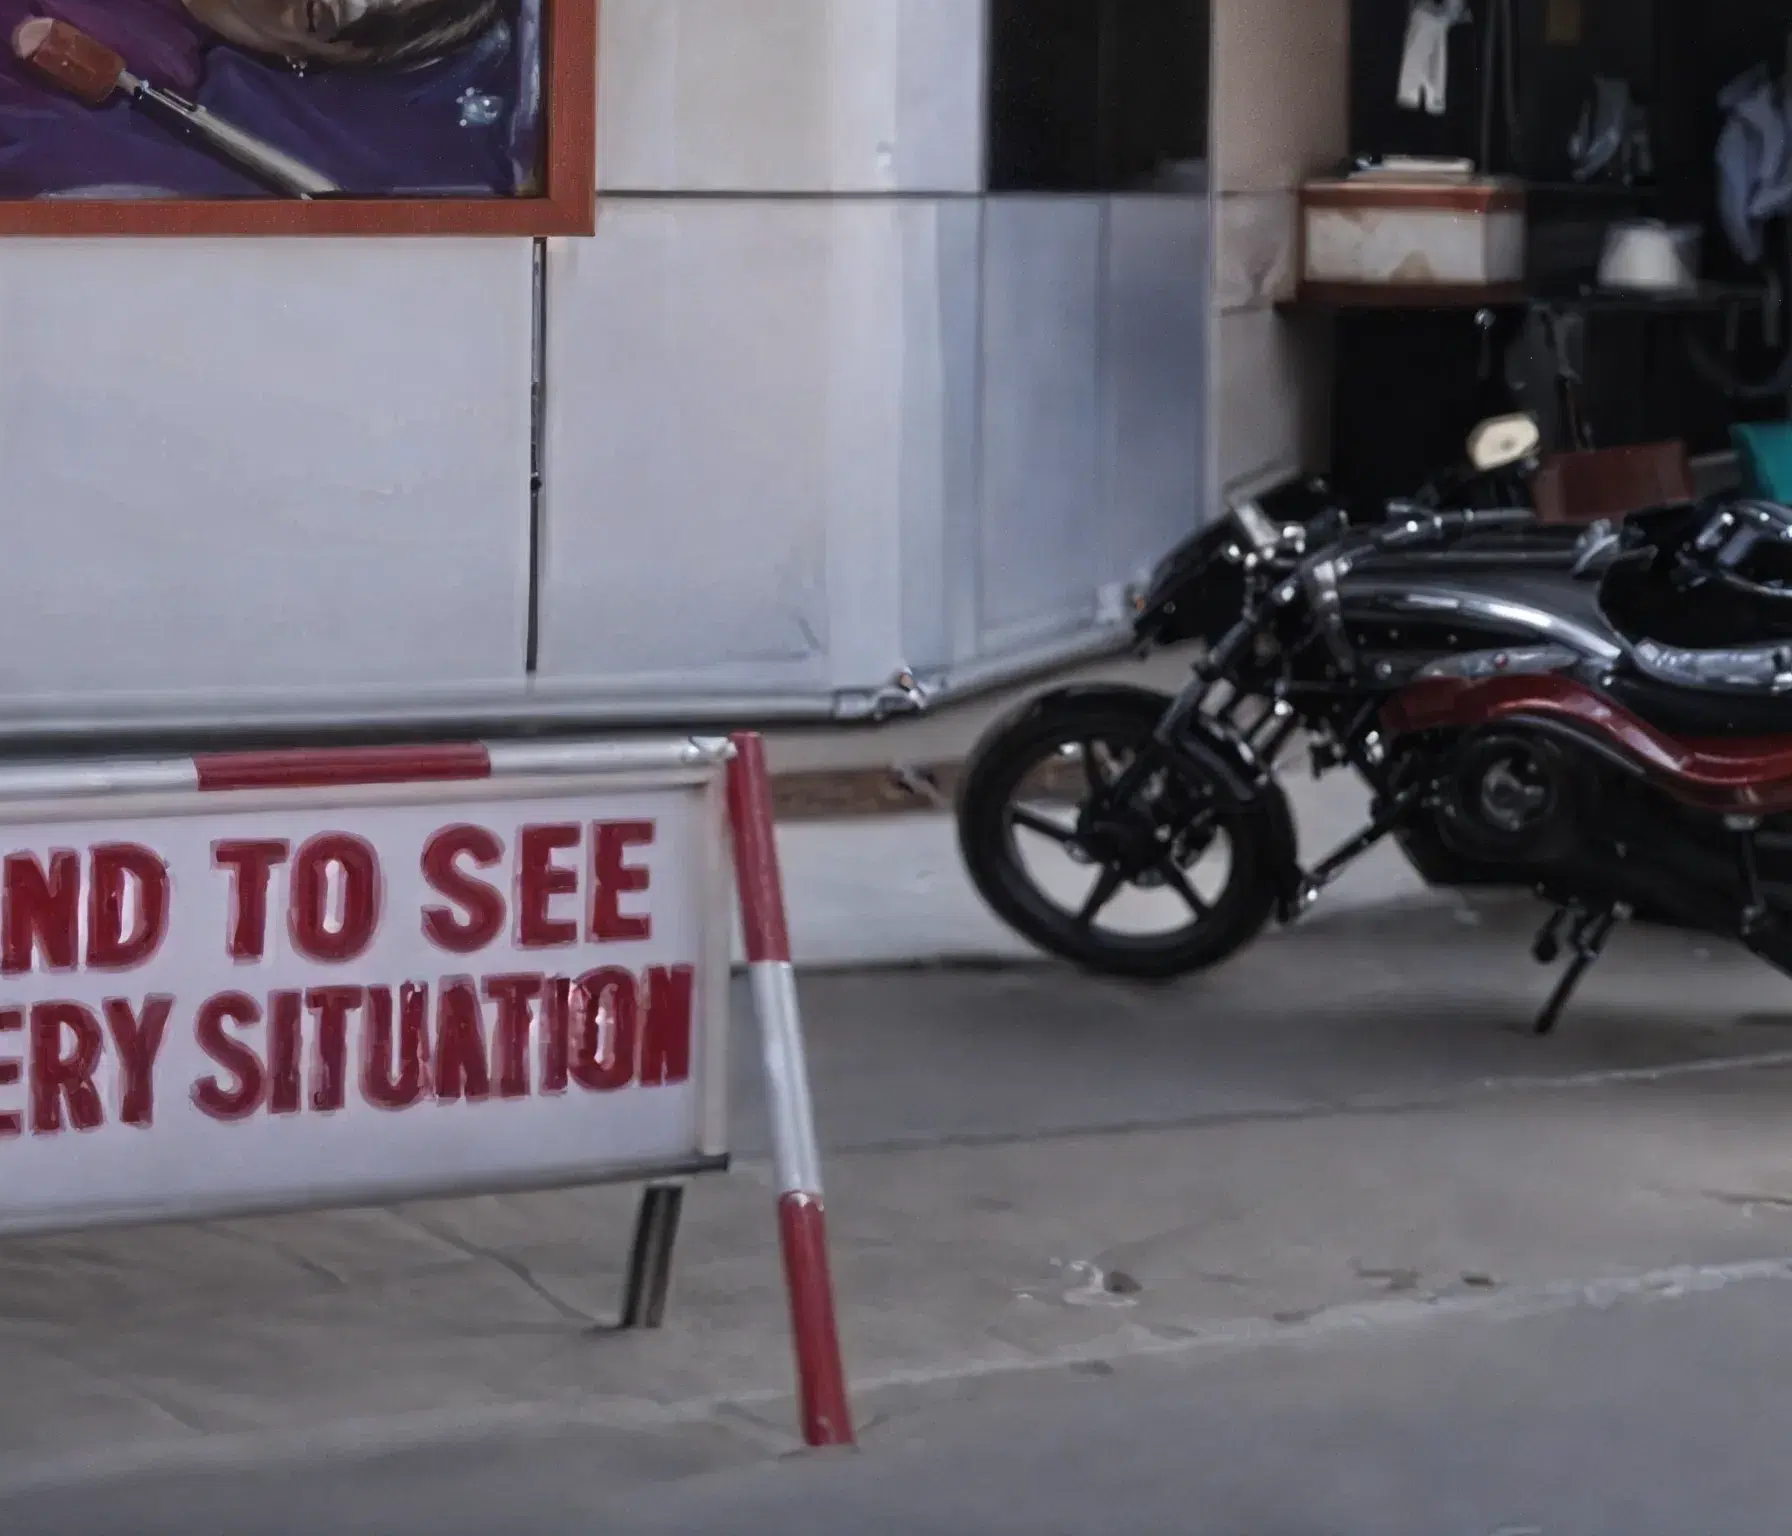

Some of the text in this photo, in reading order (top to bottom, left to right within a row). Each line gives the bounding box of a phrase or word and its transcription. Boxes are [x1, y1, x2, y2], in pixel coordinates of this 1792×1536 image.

[210, 829, 387, 964] TO
[420, 818, 657, 954] SEE
[189, 964, 696, 1122] SITUATION
